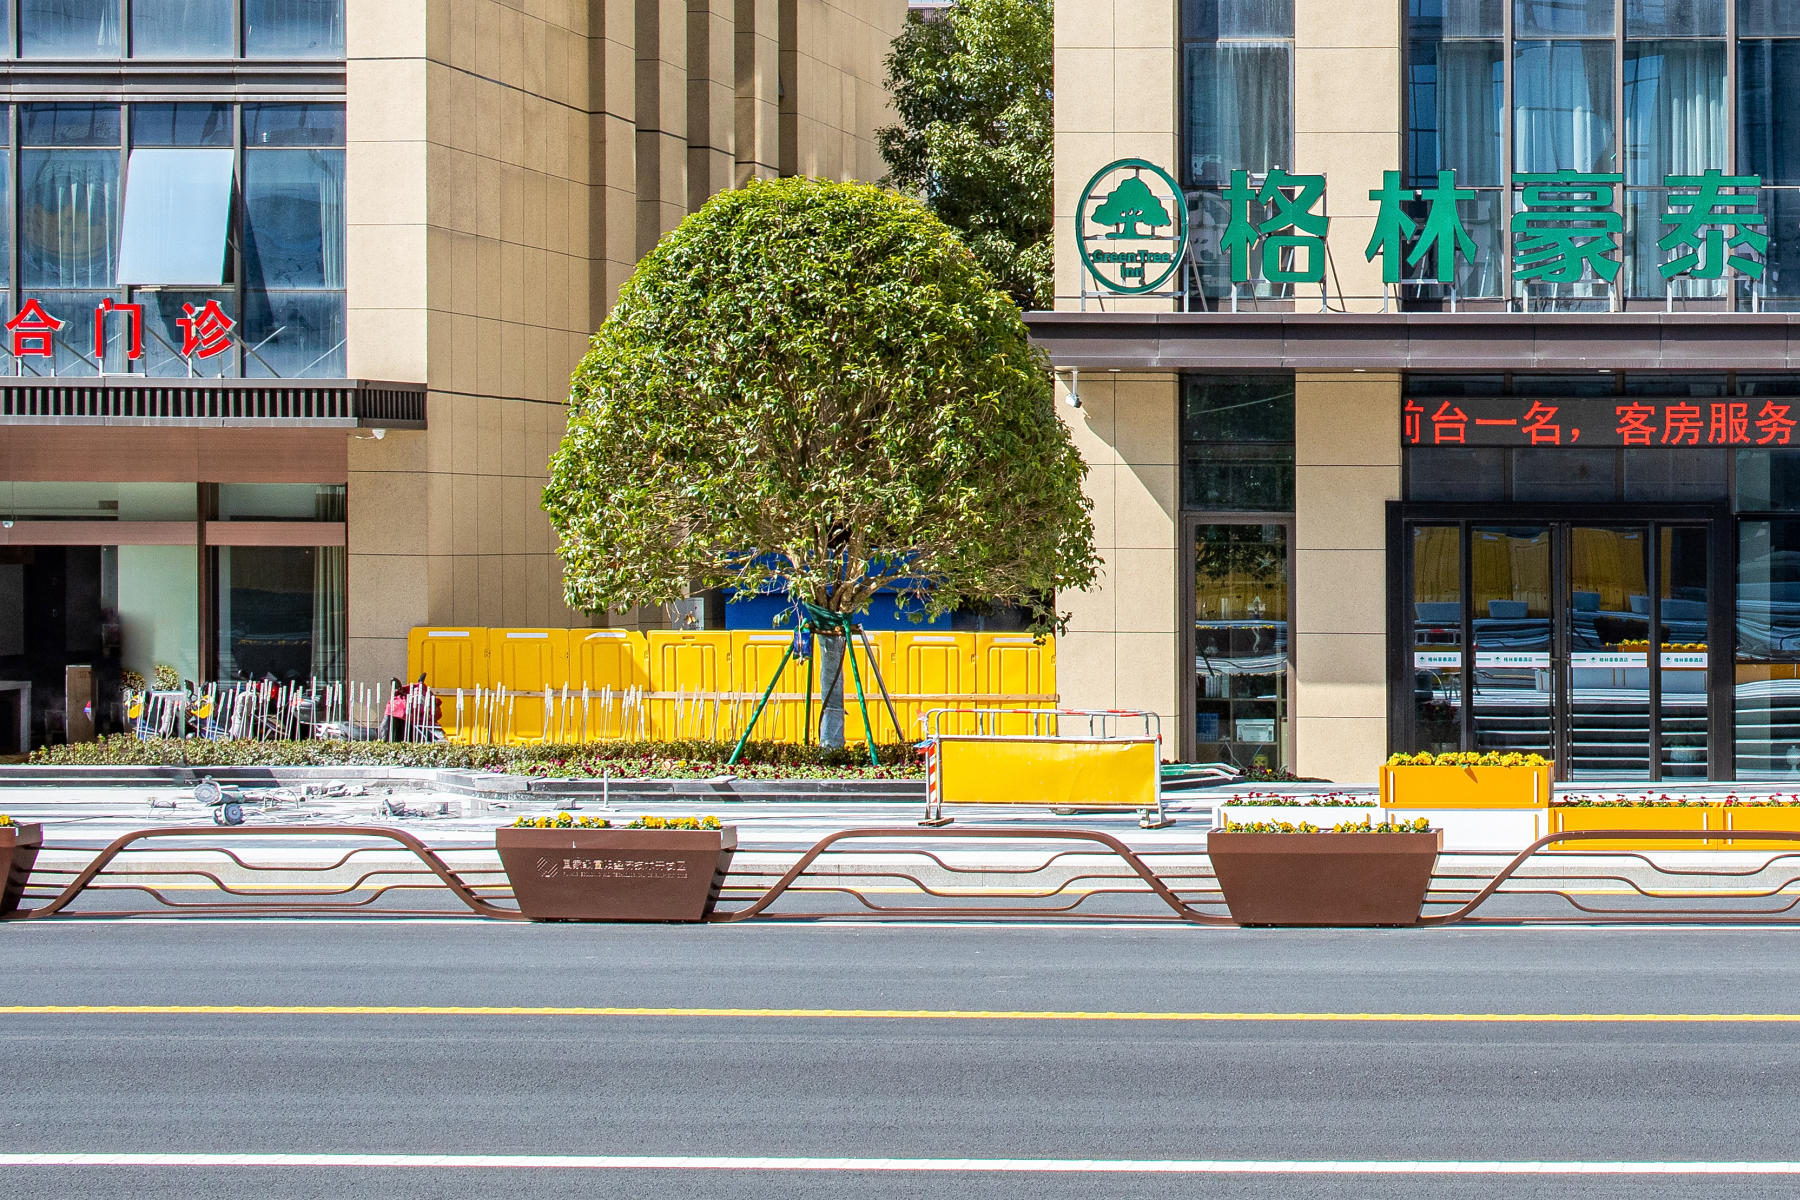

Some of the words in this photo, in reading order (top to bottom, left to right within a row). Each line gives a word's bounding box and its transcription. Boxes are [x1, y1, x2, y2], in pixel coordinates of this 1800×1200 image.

[1120, 264, 1145, 278] Inn
[5, 297, 236, 361] 合门诊
